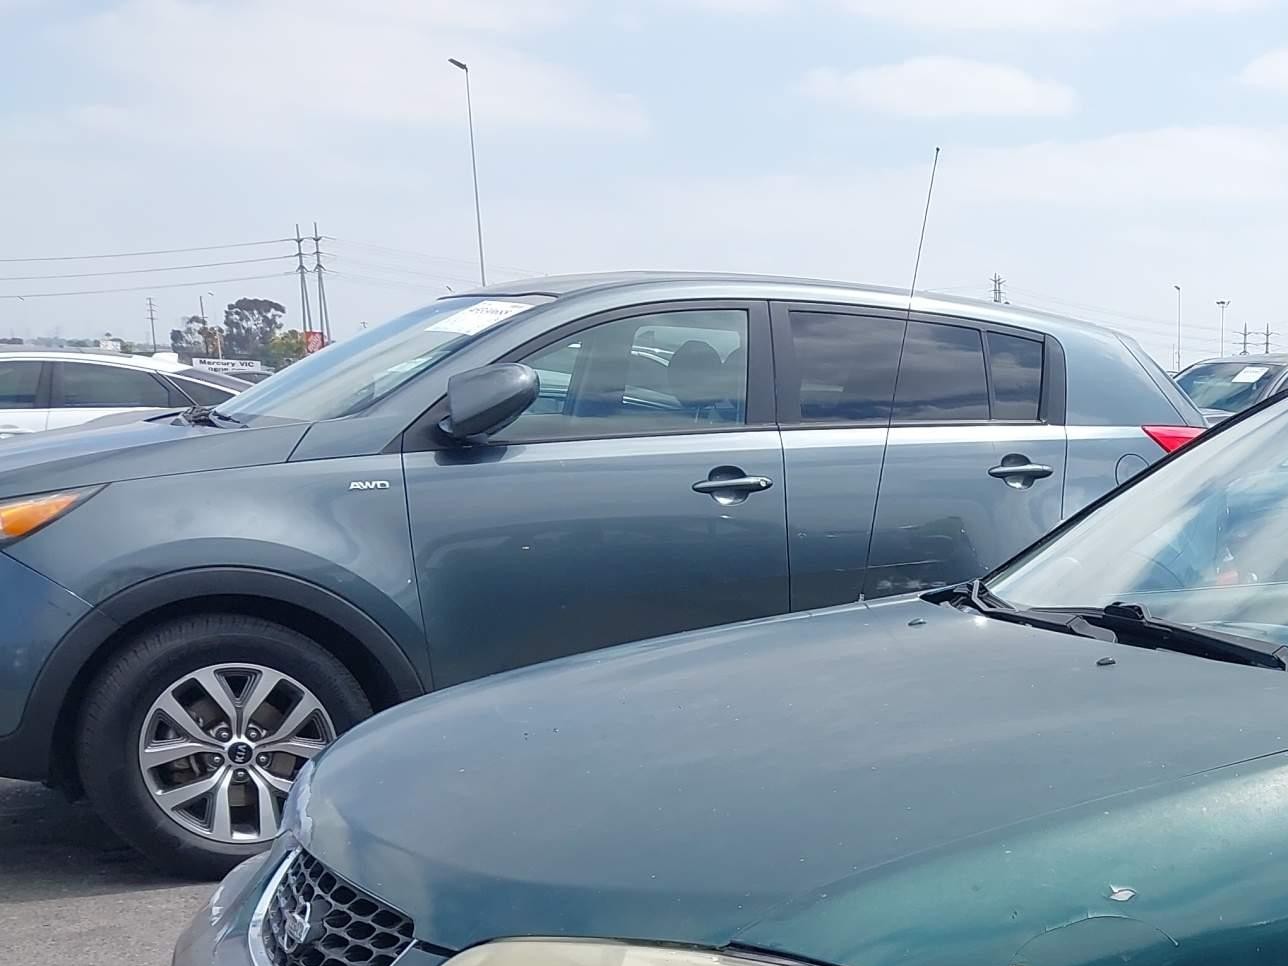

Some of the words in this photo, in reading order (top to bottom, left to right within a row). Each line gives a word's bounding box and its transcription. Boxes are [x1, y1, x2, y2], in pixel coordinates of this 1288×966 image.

[199, 359, 236, 368] Mercury
[349, 480, 390, 490] AWD
[234, 744, 248, 763] KIA
